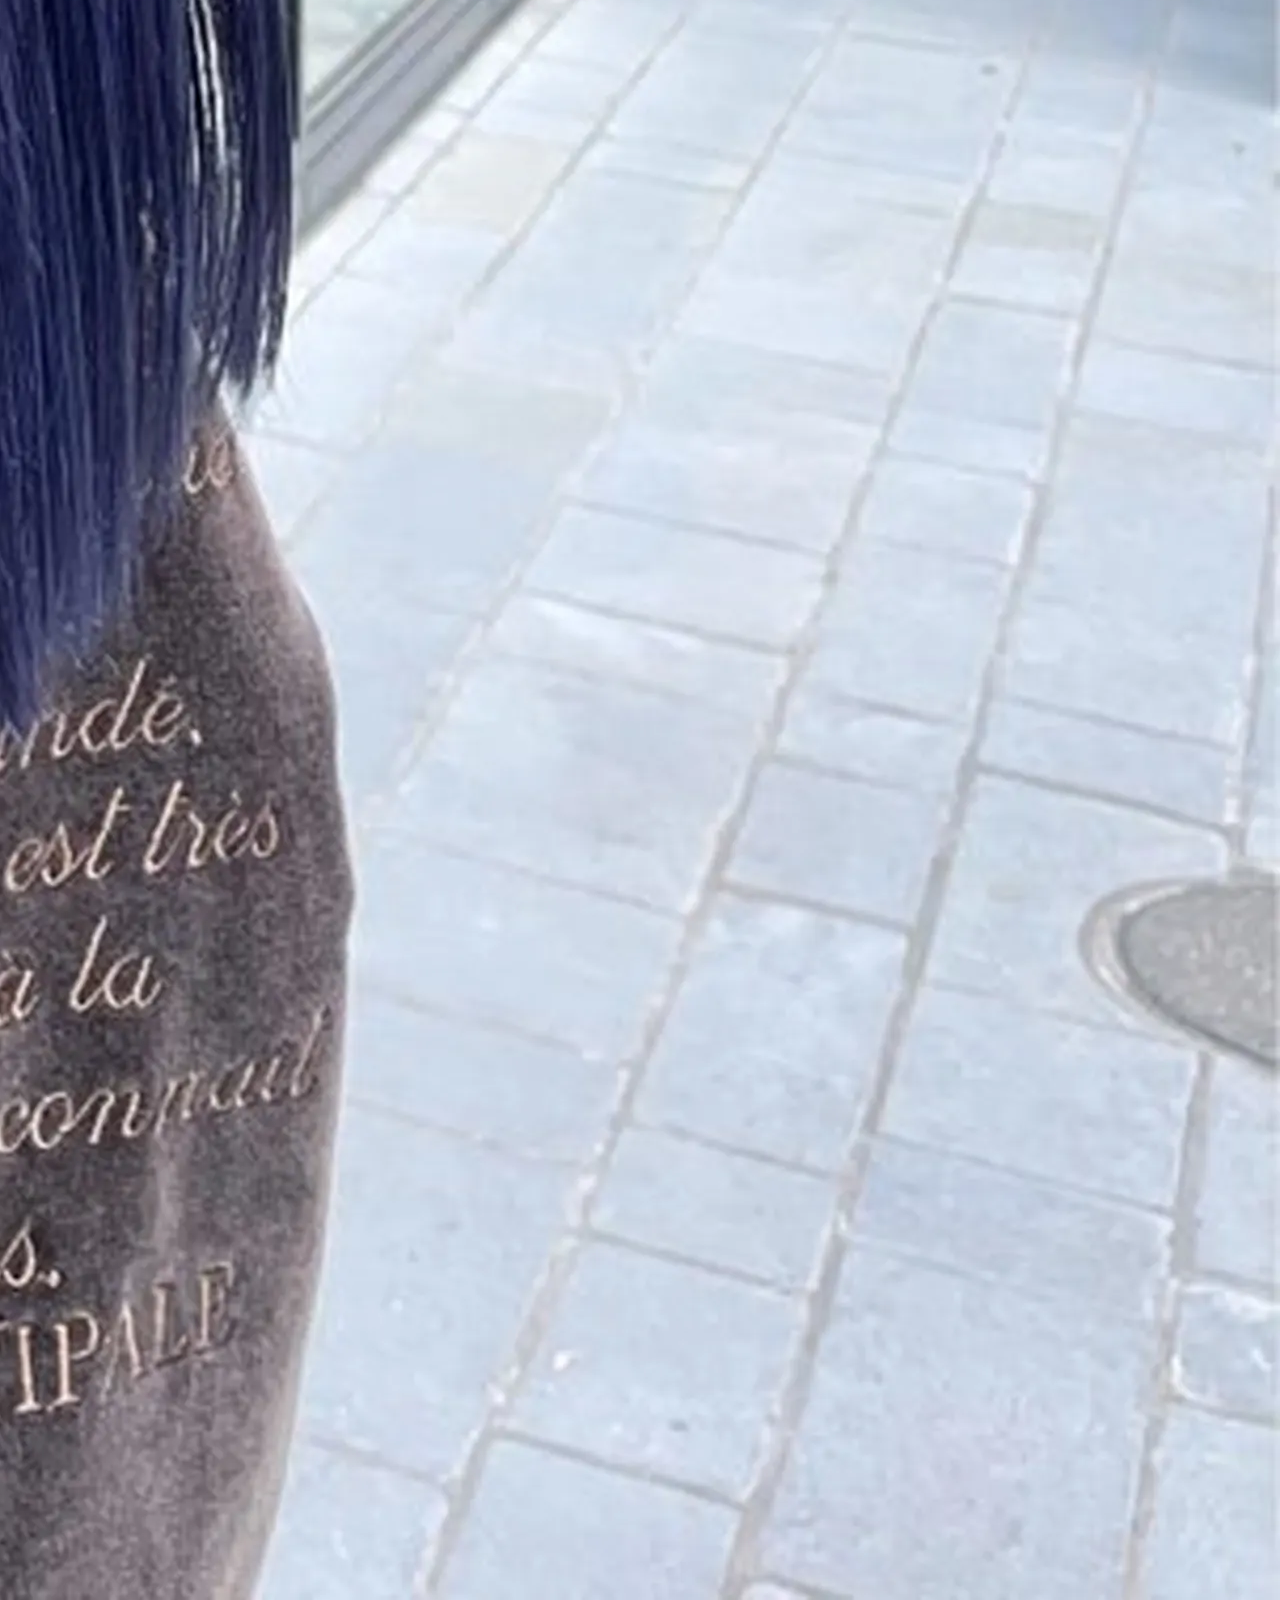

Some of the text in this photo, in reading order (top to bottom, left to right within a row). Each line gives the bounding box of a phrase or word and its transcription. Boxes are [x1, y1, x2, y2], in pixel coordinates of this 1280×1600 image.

[3, 786, 128, 893] est
[143, 778, 280, 874] très
[69, 916, 162, 1013] la
